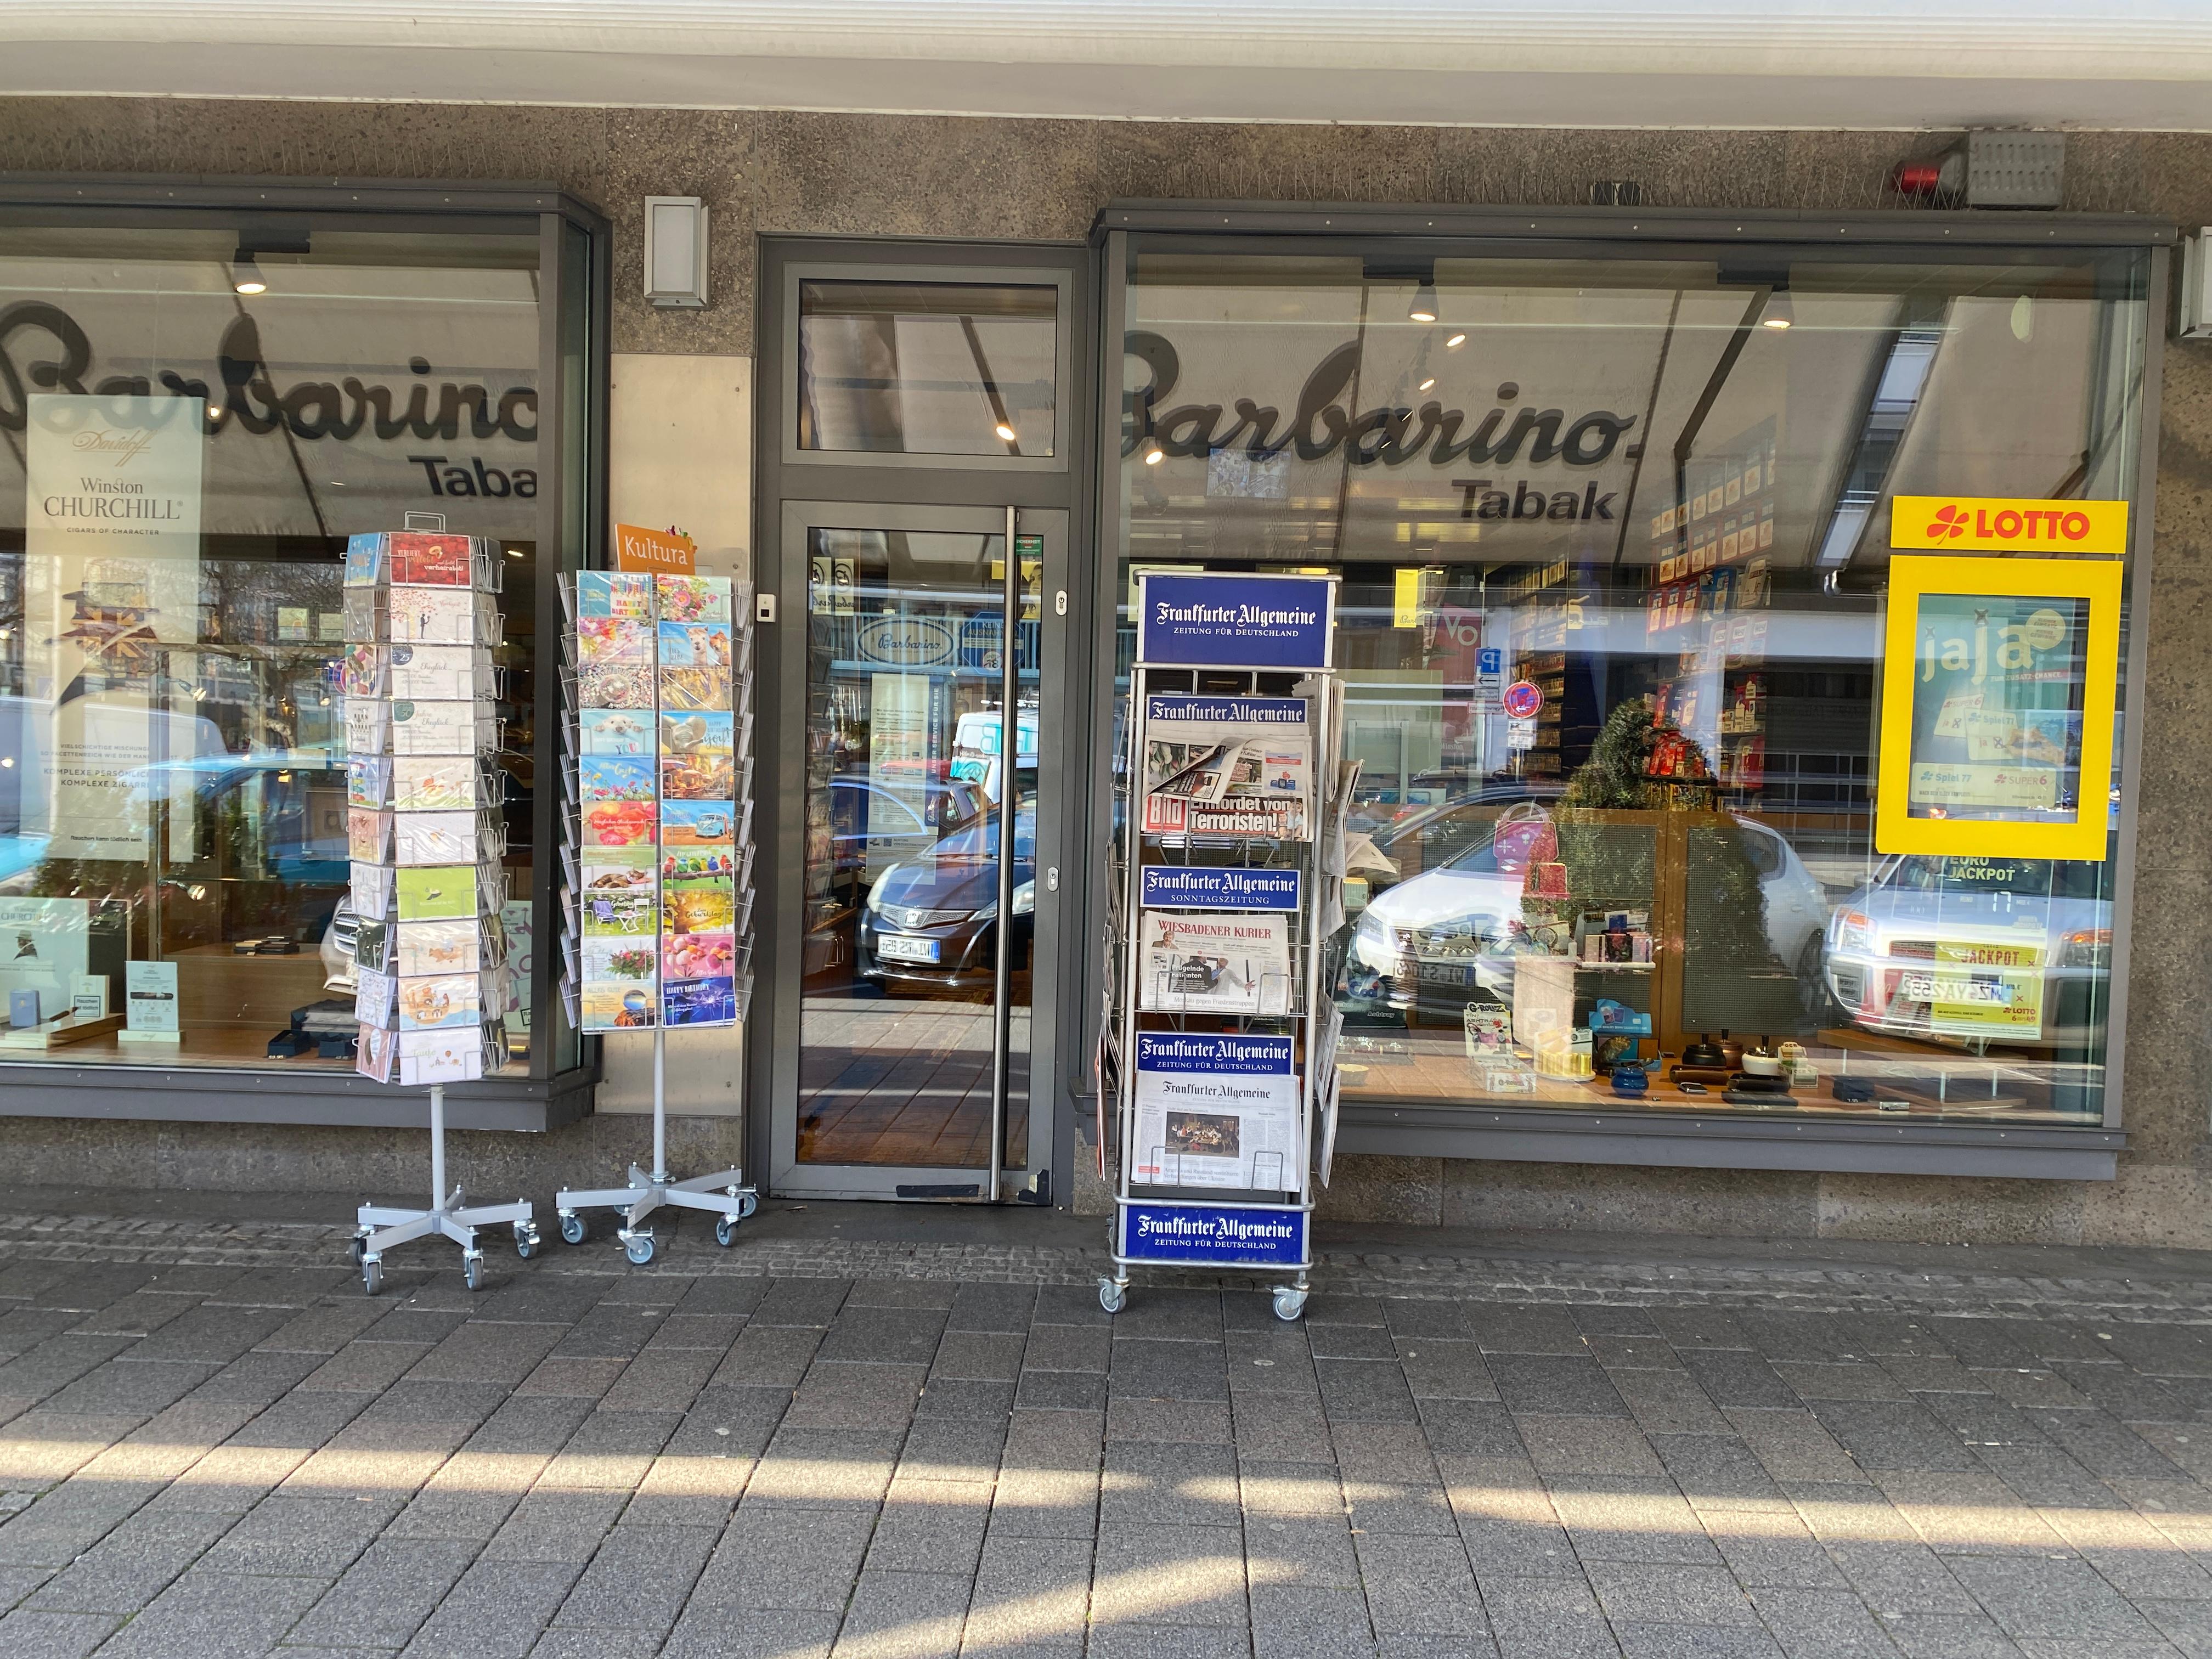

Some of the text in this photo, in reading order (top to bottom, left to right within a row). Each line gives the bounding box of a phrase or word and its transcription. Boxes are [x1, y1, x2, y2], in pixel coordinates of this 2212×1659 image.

[1121, 330, 1637, 470] Barbarino
[80, 477, 143, 494] Winston
[1451, 479, 1620, 524] Tabak
[44, 496, 180, 520] CHURCHILL
[1976, 509, 2091, 541] LOTTO
[397, 549, 421, 557] VERLIEBT
[625, 535, 688, 566] Kultura
[1156, 601, 1316, 627] Frankfurter Allgemeine
[1215, 627, 1232, 635] FÜR
[878, 633, 941, 649] Barbarino
[399, 653, 410, 662] 25
[420, 662, 448, 674] Eheglück
[401, 710, 411, 718] 50
[1152, 702, 1302, 723] Frankfurter Allgemeine
[421, 718, 449, 730] Eheglück
[1942, 719, 1949, 727] ja
[1983, 714, 2015, 725] Spiel 77
[614, 742, 637, 755] YOU
[1978, 738, 1988, 747] ja
[43, 768, 92, 776] KOMPLEXE
[1935, 773, 1972, 783] Spiel 77
[2008, 776, 2038, 786] SUPER
[1151, 795, 1183, 825] Bild
[1263, 800, 1290, 811] von
[1190, 811, 1278, 832] Terroristen!
[1950, 857, 1990, 866] EURO
[1950, 867, 2016, 882] JACKPOT
[1147, 871, 1295, 894] Frankfurter Allgemeine
[1171, 894, 1269, 904] SONNTAGSZEITUNG
[685, 911, 724, 919] Geburtstag
[1158, 919, 1271, 939] WIESBADENER KURIER
[1961, 949, 2019, 966] JACKPOT
[1172, 964, 1204, 973] Prügelnde
[685, 984, 710, 992] BIRTHDAY
[1173, 996, 1255, 1007] Moskau gegen Friedenstruppen
[413, 1048, 437, 1058] Taufe
[1141, 1039, 1289, 1063] Frankfurter Allgemeine
[1195, 1061, 1211, 1069] FÜR
[1215, 1063, 1273, 1071] DEUTSCHLAND
[1163, 1081, 1270, 1099] Frankfurter Allgemeine
[1138, 1215, 1293, 1241] Frankfurter Allgemeine
[1215, 1241, 1276, 1250] DEUTSCHLAND
